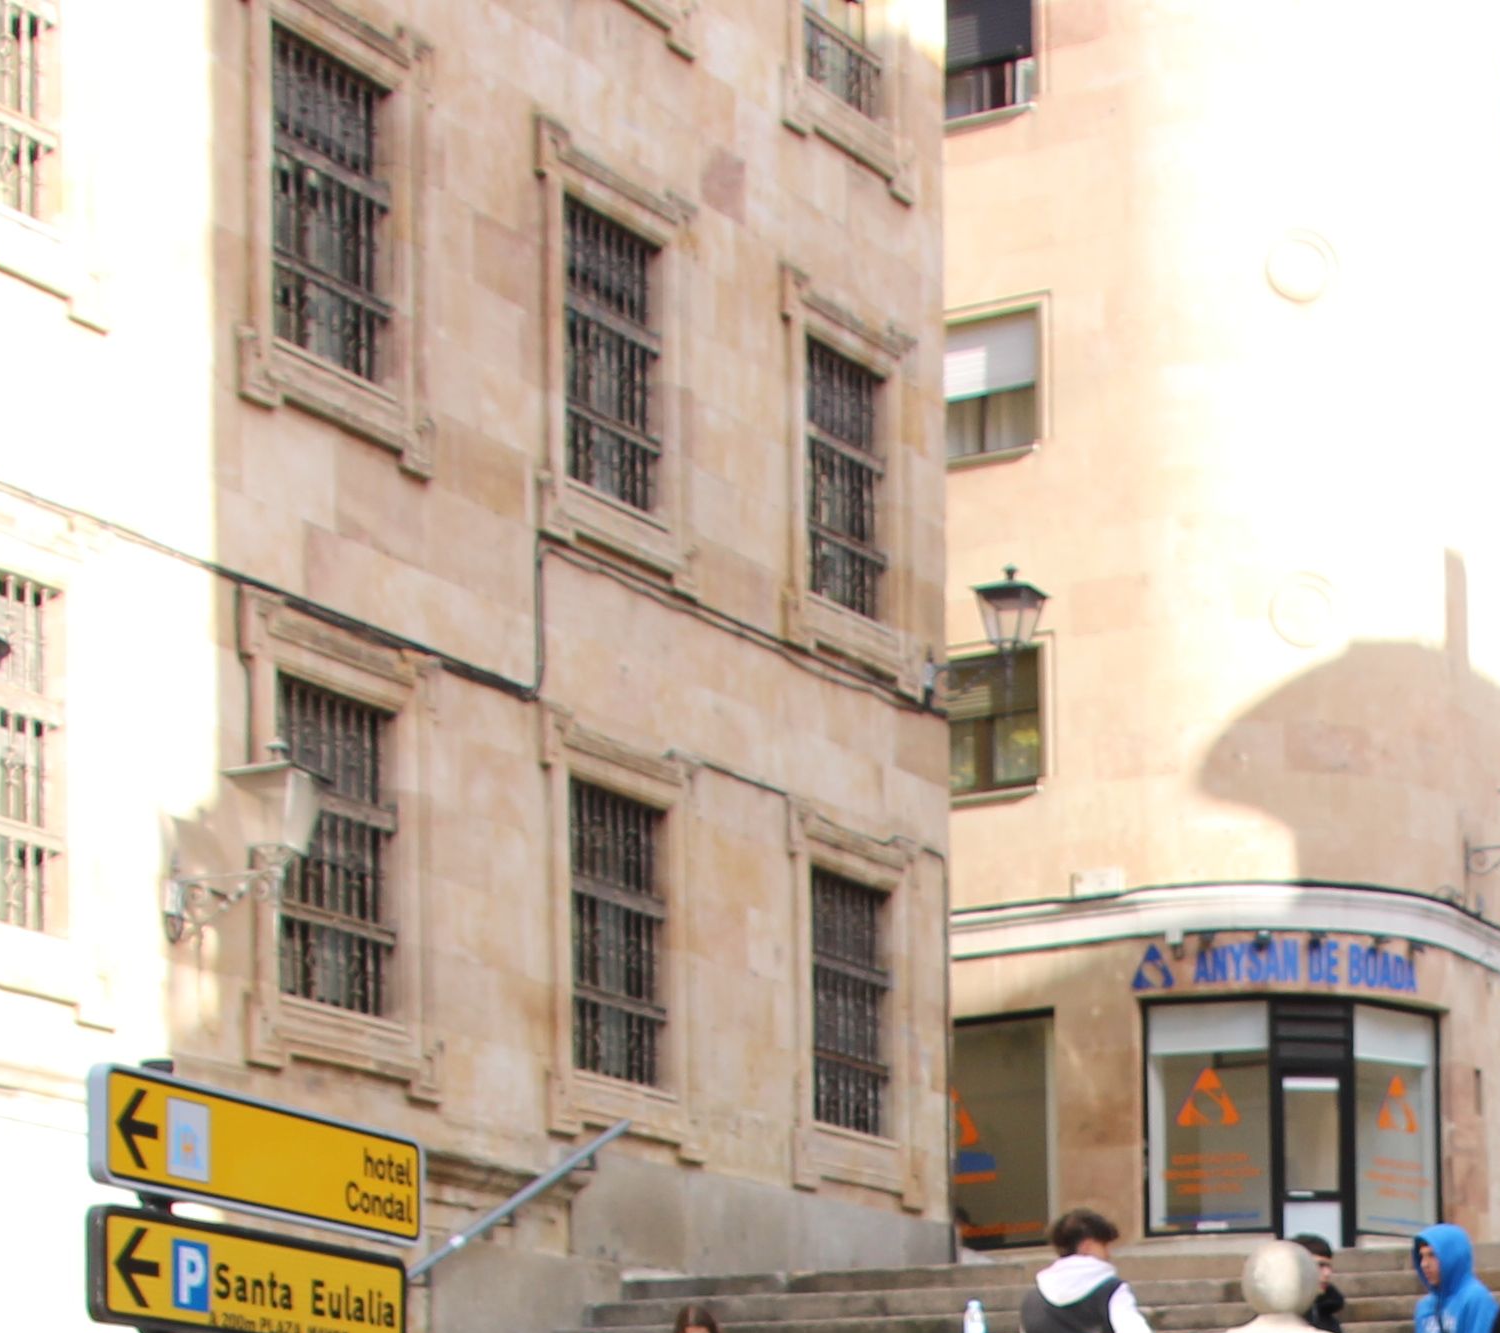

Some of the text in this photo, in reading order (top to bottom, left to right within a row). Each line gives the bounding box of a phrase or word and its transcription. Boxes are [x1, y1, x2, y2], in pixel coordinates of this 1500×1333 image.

[1194, 939, 1417, 992] ANYSAN DE BOADA
[363, 1148, 413, 1187] hotel
[345, 1181, 414, 1224] Condal
[178, 1245, 396, 1328] P Santa Eulalia
[221, 1311, 256, 1333] 200m
